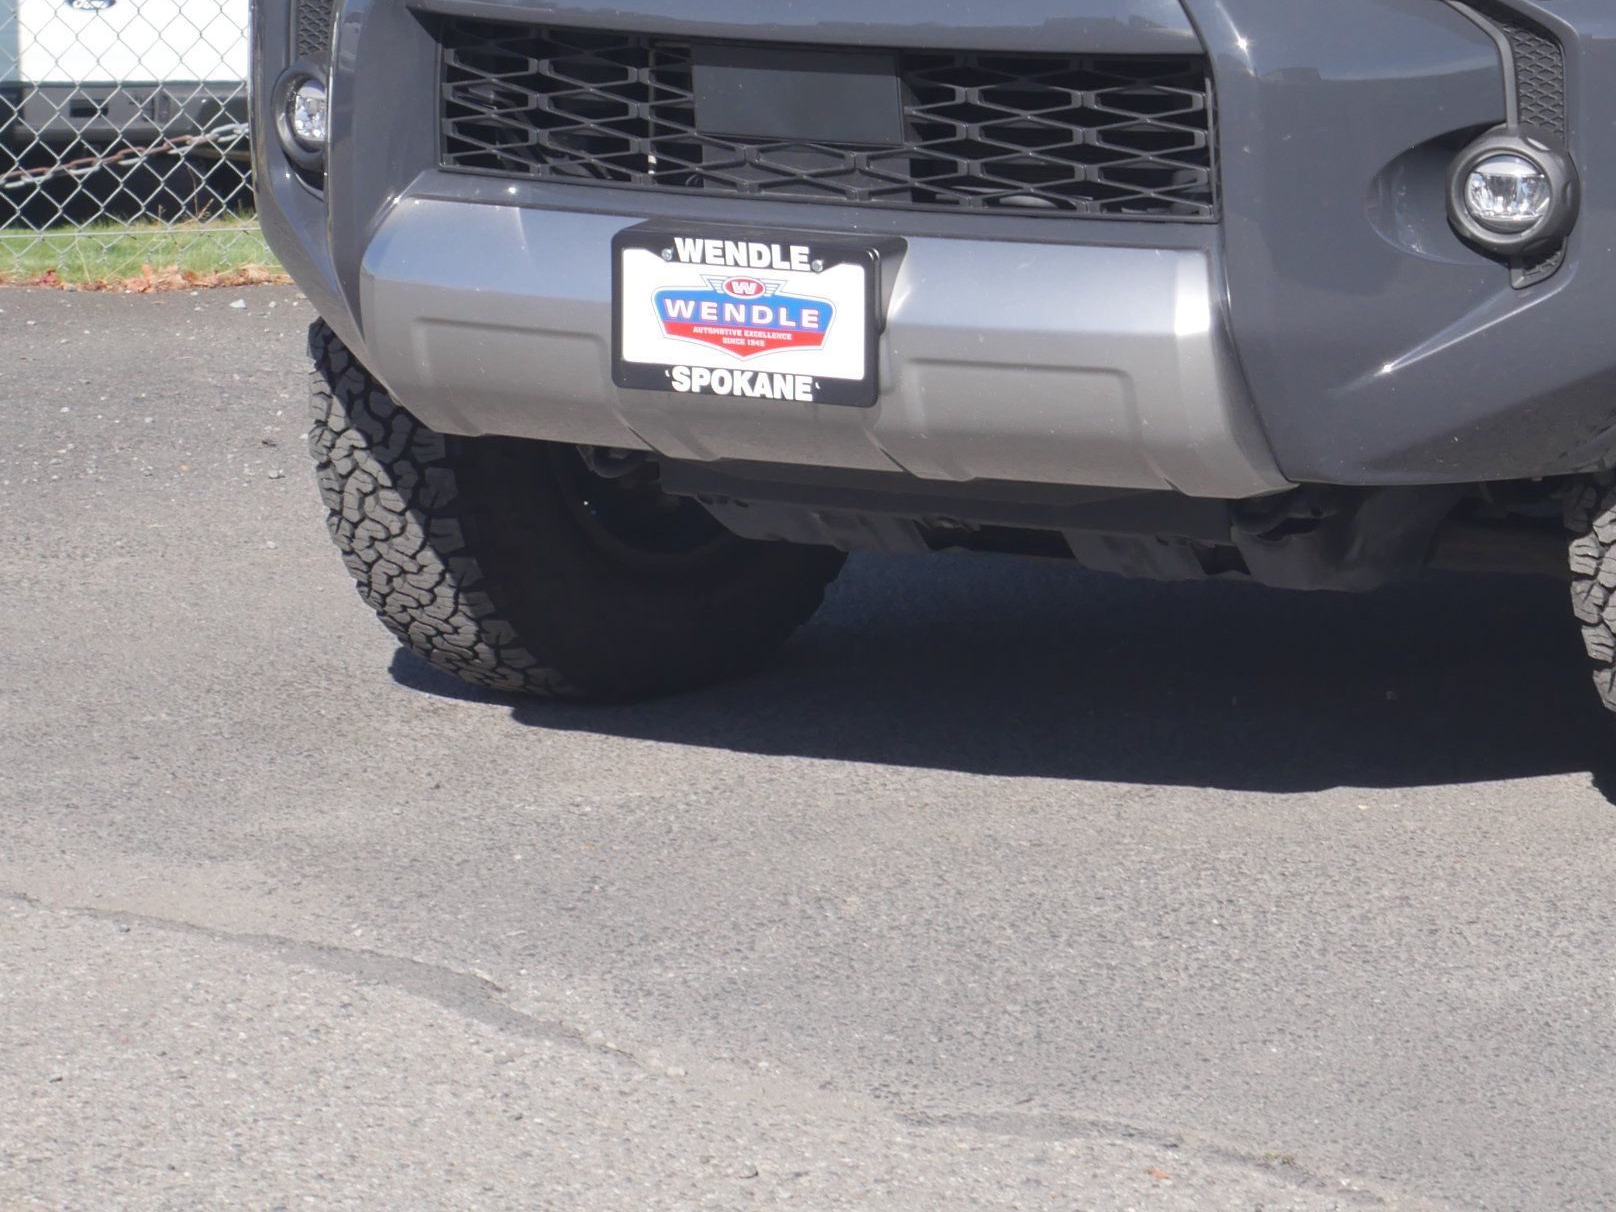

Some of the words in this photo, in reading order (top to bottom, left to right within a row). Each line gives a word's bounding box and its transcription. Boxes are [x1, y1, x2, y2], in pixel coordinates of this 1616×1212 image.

[674, 237, 811, 271] WENDLE
[664, 298, 819, 328] WENDLE
[693, 326, 742, 337] AUTOMOTIVE
[743, 330, 792, 340] EXCELLENCE
[722, 337, 745, 346] SINCE
[672, 365, 813, 401] SPOKANE
